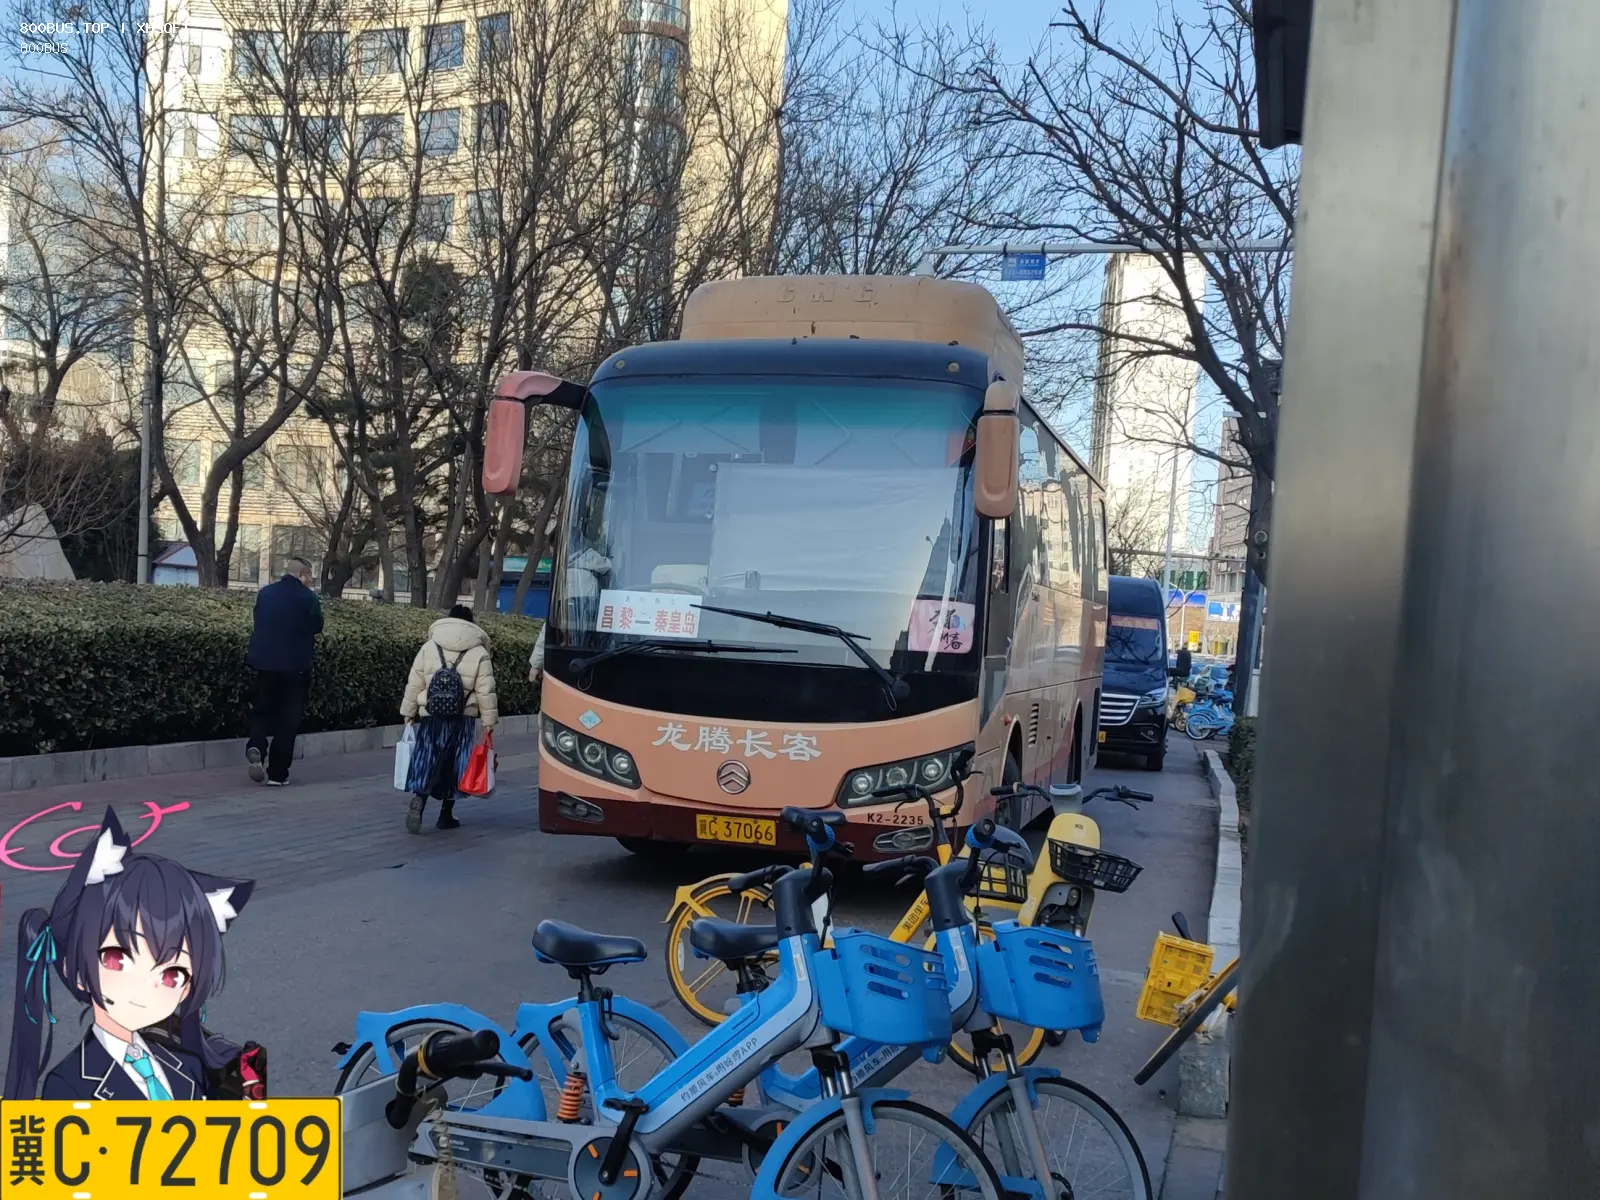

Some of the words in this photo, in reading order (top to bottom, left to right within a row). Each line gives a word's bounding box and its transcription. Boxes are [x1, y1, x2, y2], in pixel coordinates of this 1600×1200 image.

[651, 721, 822, 762] 龙腾长客
[867, 812, 924, 825] K2-2235
